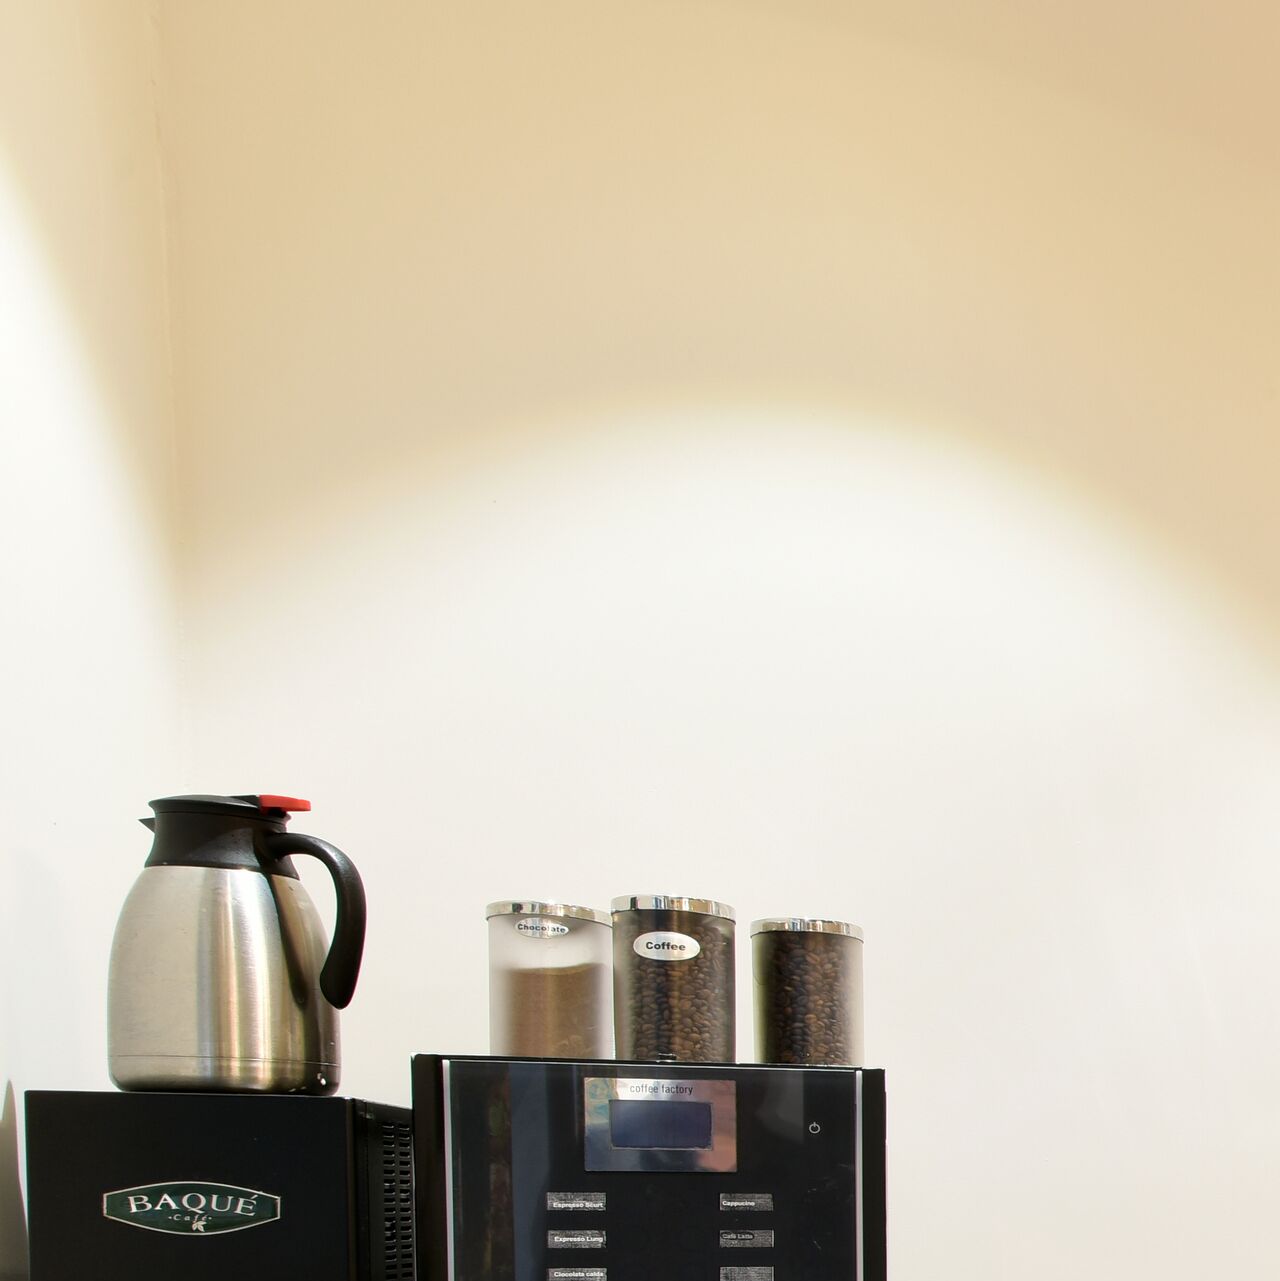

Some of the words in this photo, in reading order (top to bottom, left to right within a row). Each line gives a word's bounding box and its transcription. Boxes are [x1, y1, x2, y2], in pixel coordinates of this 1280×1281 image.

[645, 941, 686, 951] Coffee
[629, 1084, 659, 1094] coffee
[661, 1084, 693, 1096] factory
[127, 1193, 259, 1217] BAQUÉ
